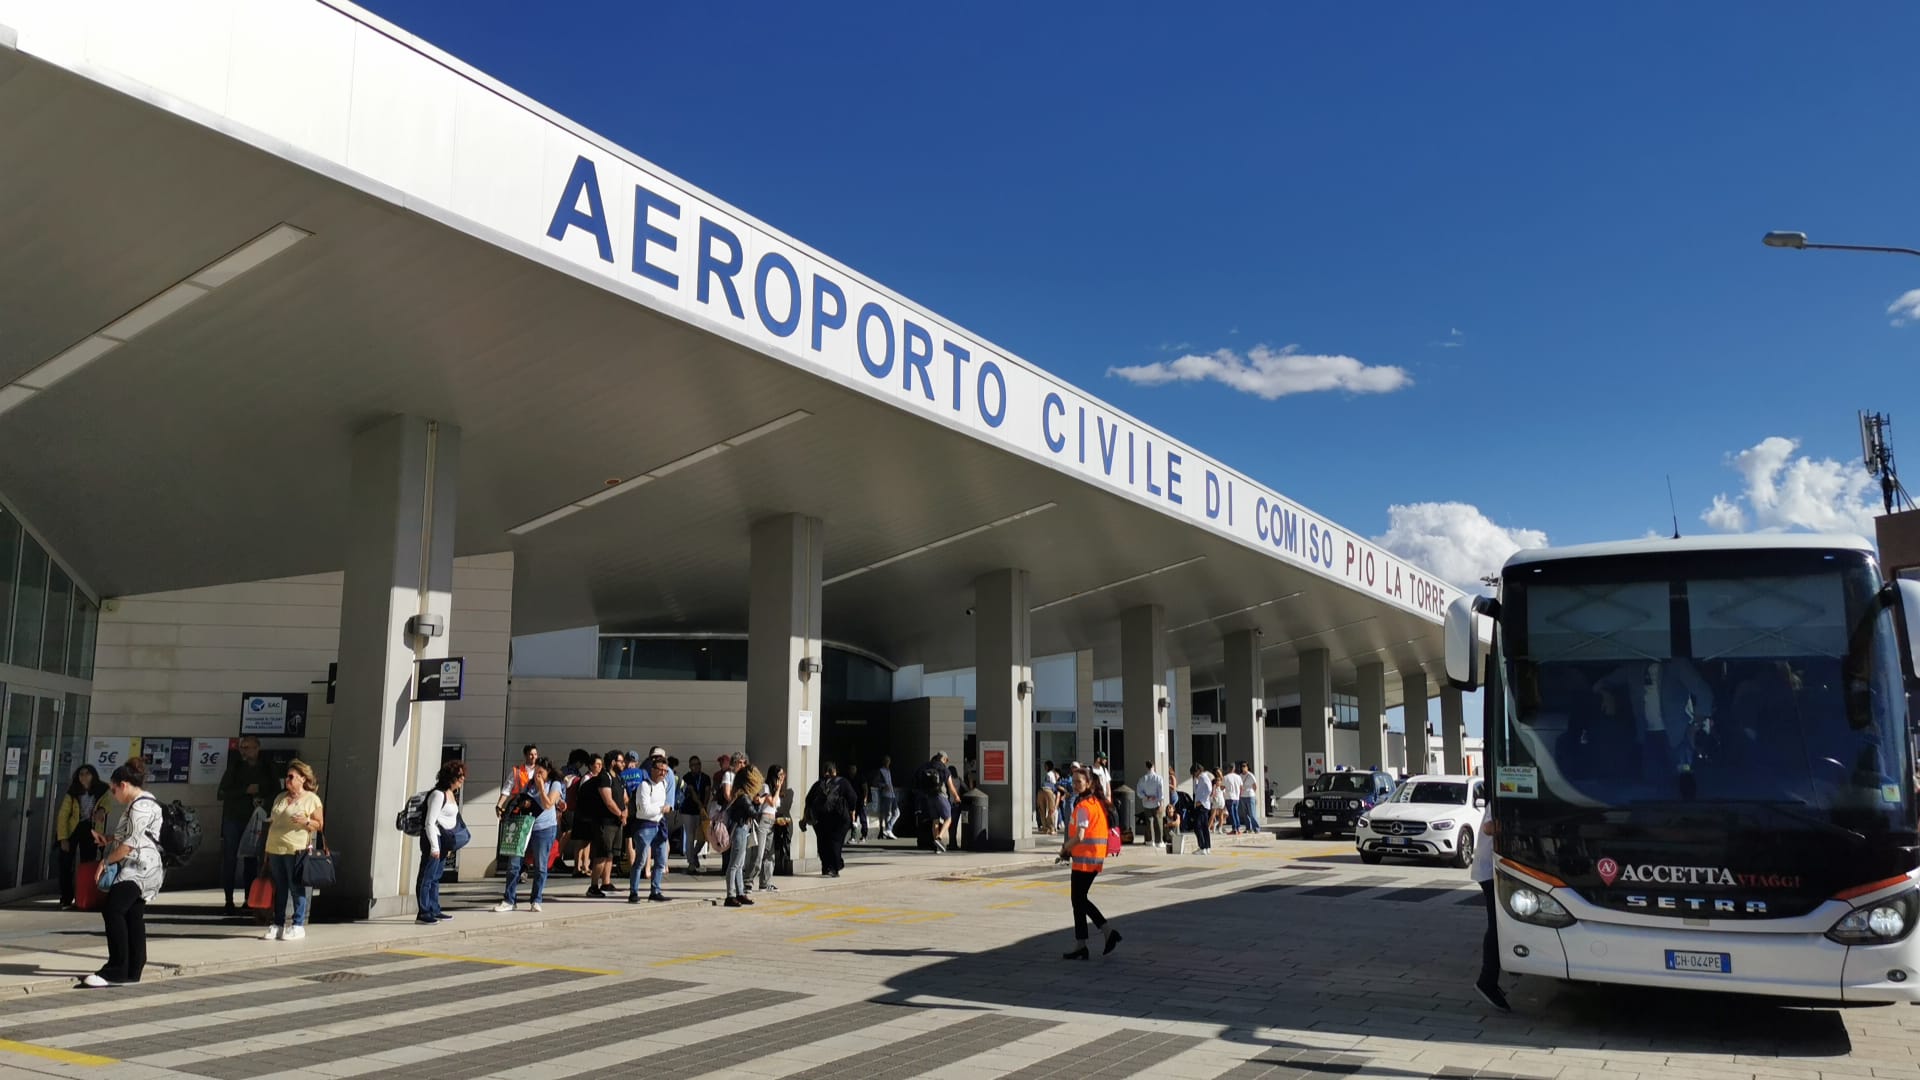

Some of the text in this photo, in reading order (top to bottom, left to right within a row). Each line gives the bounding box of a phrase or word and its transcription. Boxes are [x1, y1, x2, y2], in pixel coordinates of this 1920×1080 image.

[546, 154, 1445, 618] AEROPORTO CIVILE DI COMISO PIO LA TORRE
[98, 751, 119, 764] 5€
[200, 752, 220, 764] 3€
[1620, 864, 1800, 887] ACCETTA VIAGGI
[1626, 895, 1767, 913] SETRA
